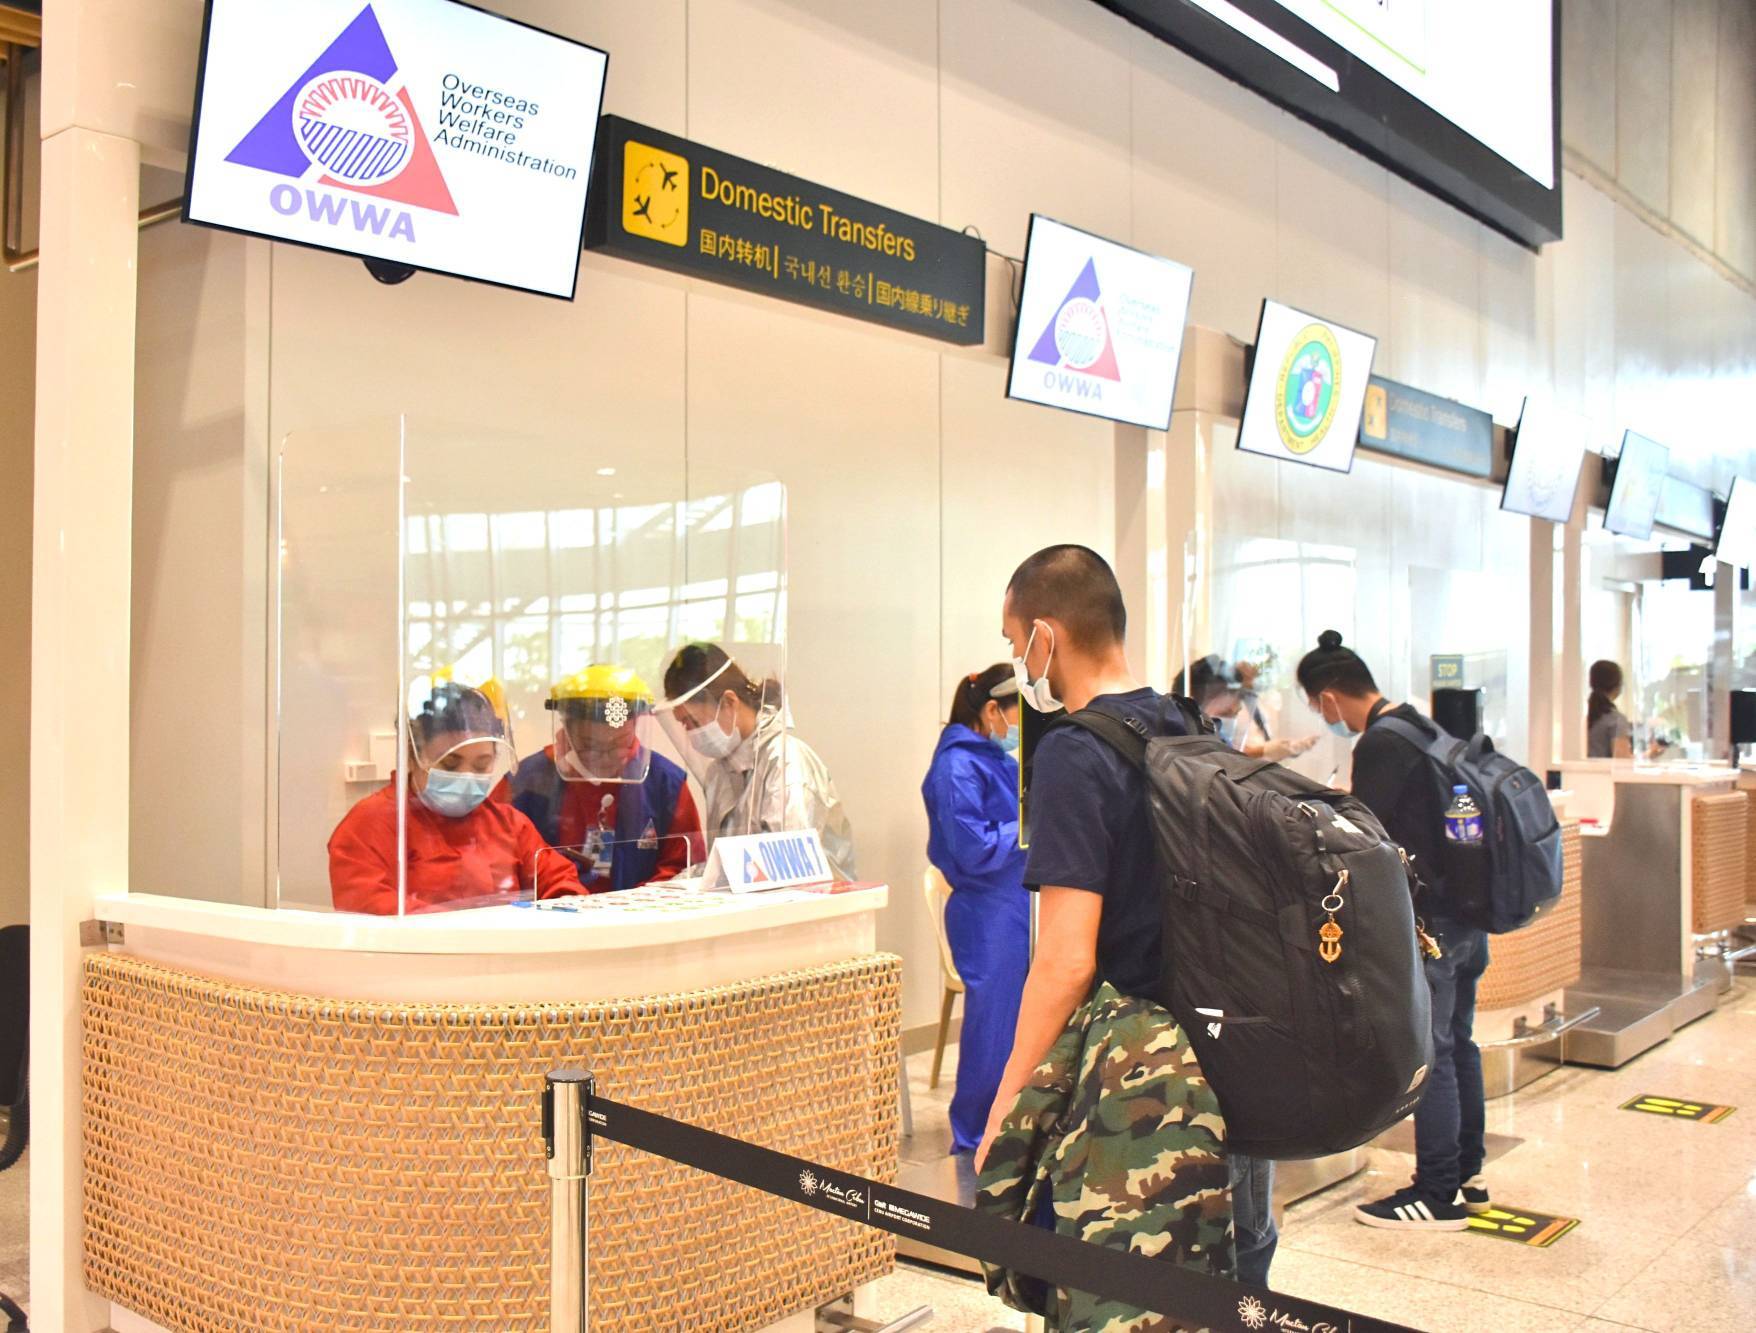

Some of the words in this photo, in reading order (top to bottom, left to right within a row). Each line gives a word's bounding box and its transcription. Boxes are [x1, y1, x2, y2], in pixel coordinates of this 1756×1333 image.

[440, 91, 525, 130] Workers
[442, 72, 539, 116] Overseas
[438, 109, 516, 146] Welfare
[433, 128, 578, 181] Administration
[269, 183, 417, 244] OWWA
[702, 166, 813, 230] Domestic
[819, 204, 916, 262] Transfers
[700, 228, 771, 271] 国内转机
[784, 255, 832, 289] 국내선
[1043, 370, 1103, 401] OWWA
[758, 837, 816, 882] OWWA
